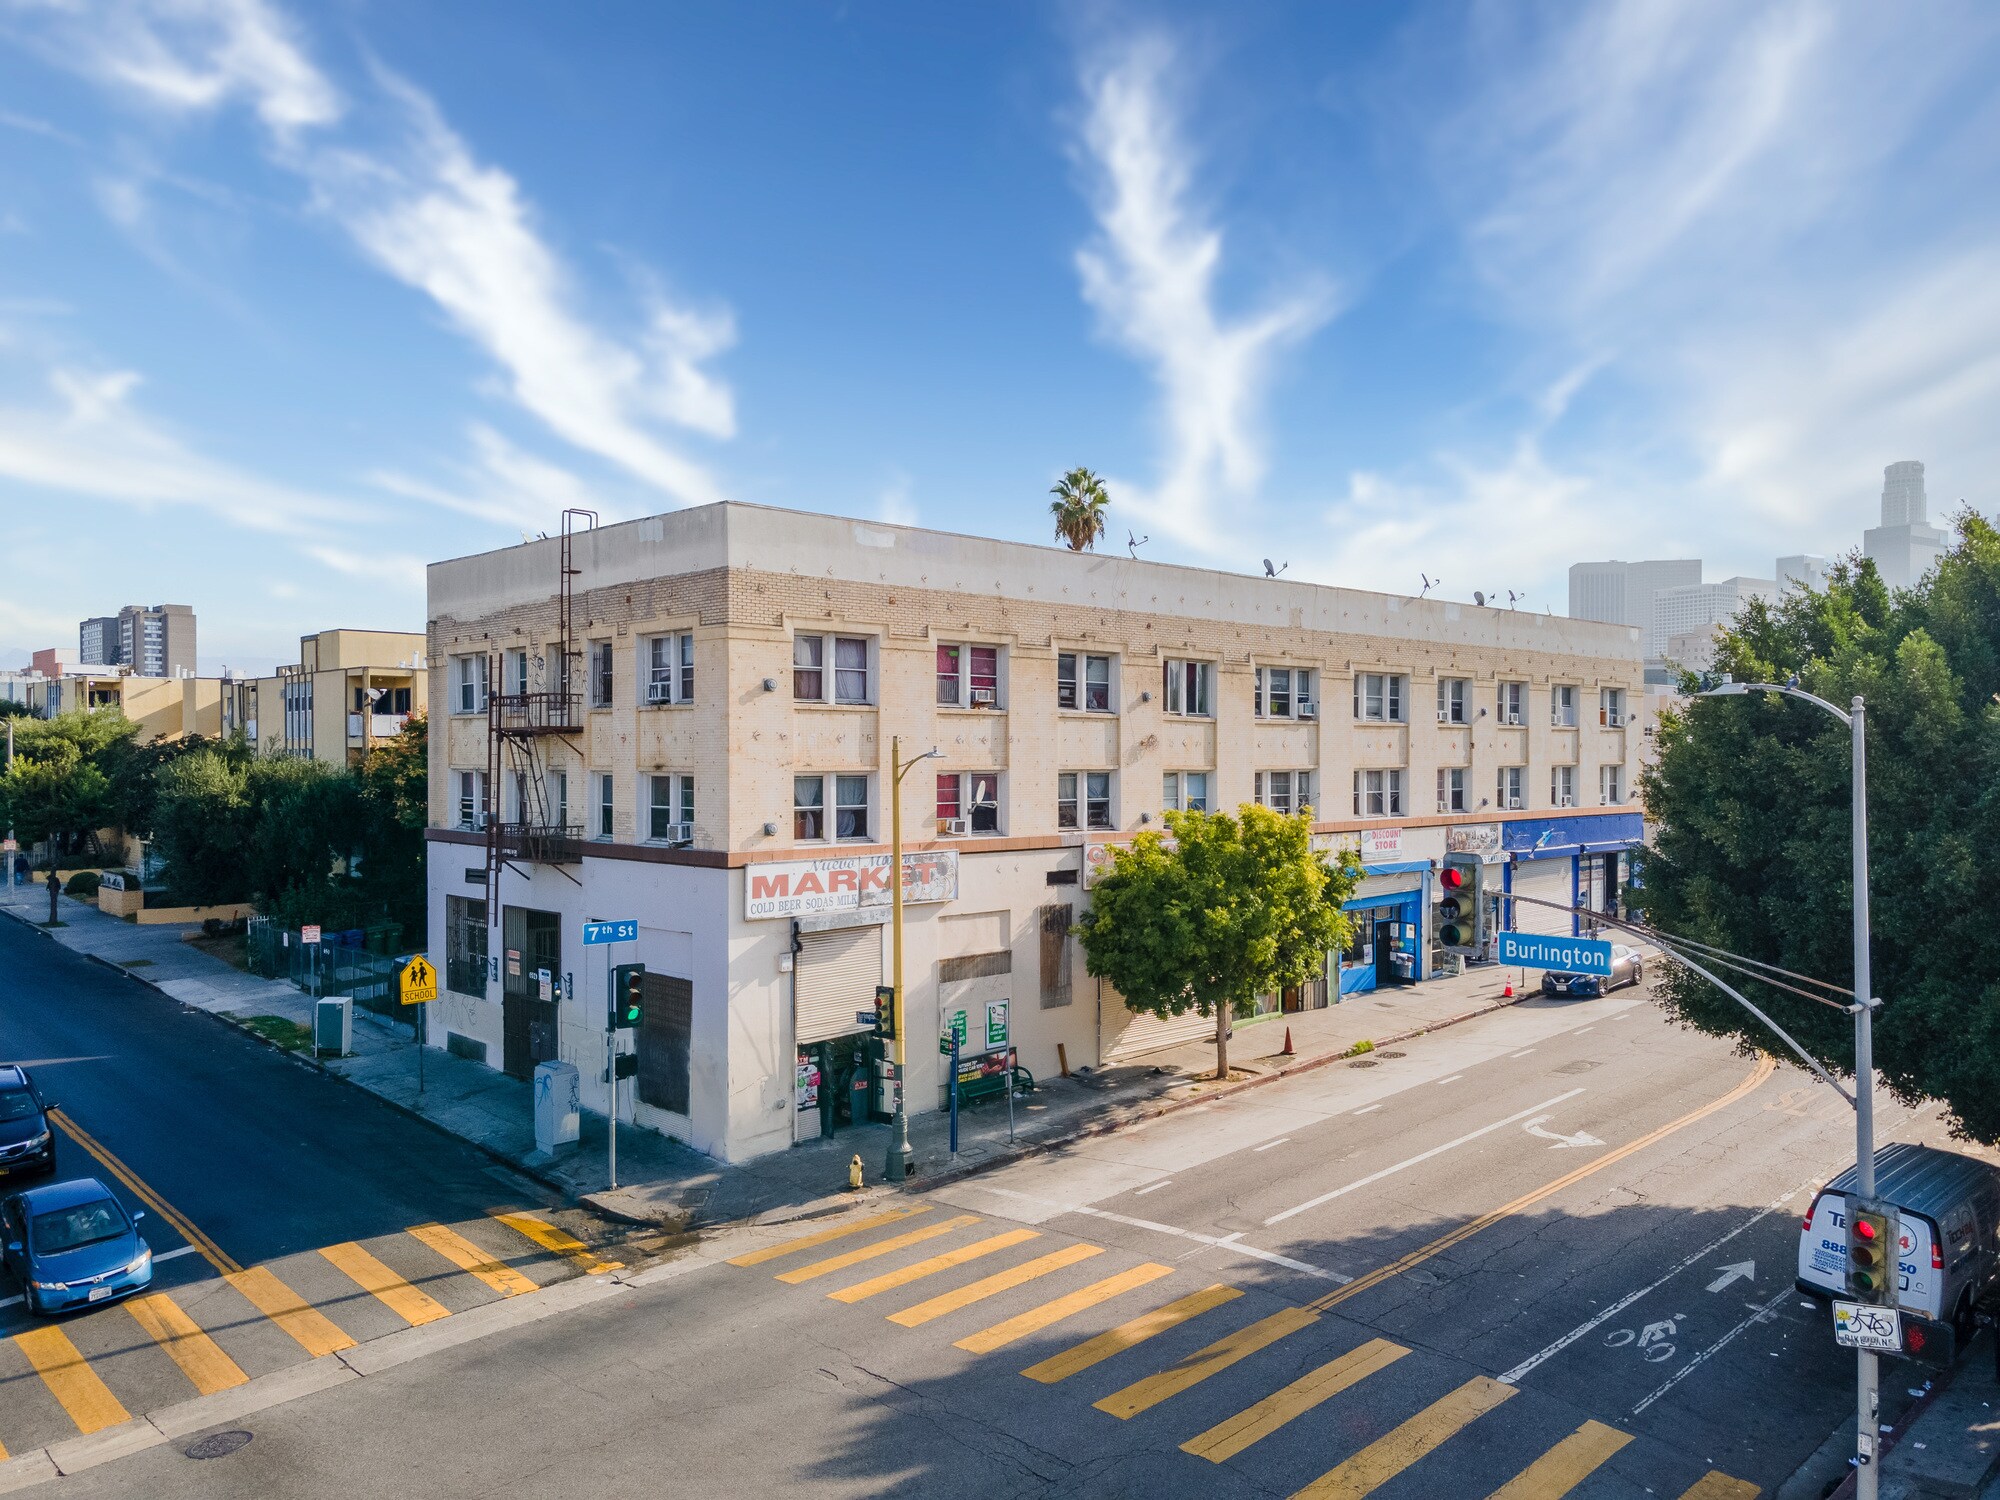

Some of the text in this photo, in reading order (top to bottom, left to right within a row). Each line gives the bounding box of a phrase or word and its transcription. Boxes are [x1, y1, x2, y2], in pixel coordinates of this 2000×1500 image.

[1371, 830, 1402, 840] DISCOUNT
[1375, 840, 1397, 850] STORE
[752, 862, 937, 899] MARKET
[751, 894, 858, 915] COLD BEER SODAS MILK
[588, 925, 634, 941] 7th St
[1505, 939, 1605, 969] Burlington
[404, 990, 435, 1001] SCHOOL
